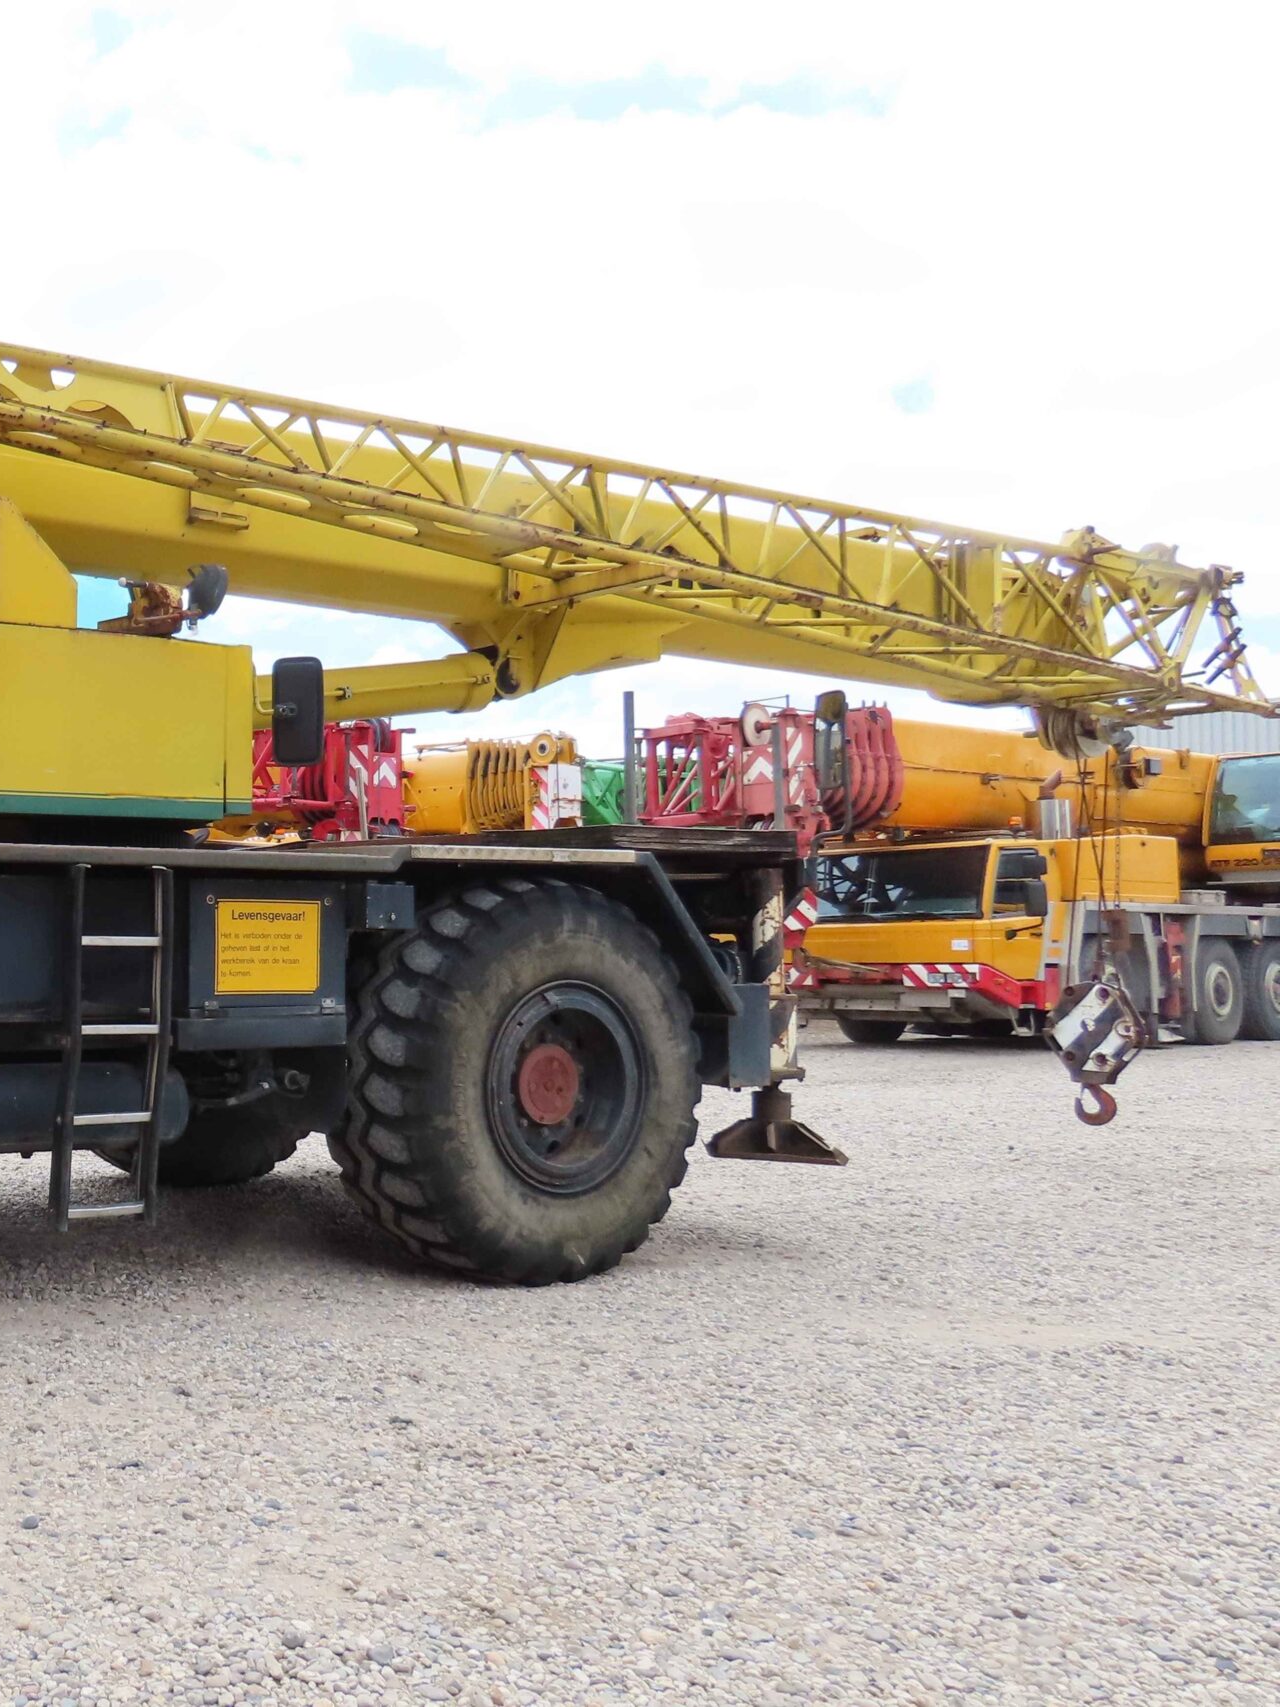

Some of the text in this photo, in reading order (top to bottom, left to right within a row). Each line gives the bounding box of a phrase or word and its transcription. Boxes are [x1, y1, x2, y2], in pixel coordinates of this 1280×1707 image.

[231, 909, 306, 922] Levensgevaar!
[274, 932, 292, 940] onder
[294, 932, 303, 940] de
[282, 957, 300, 965] kraan
